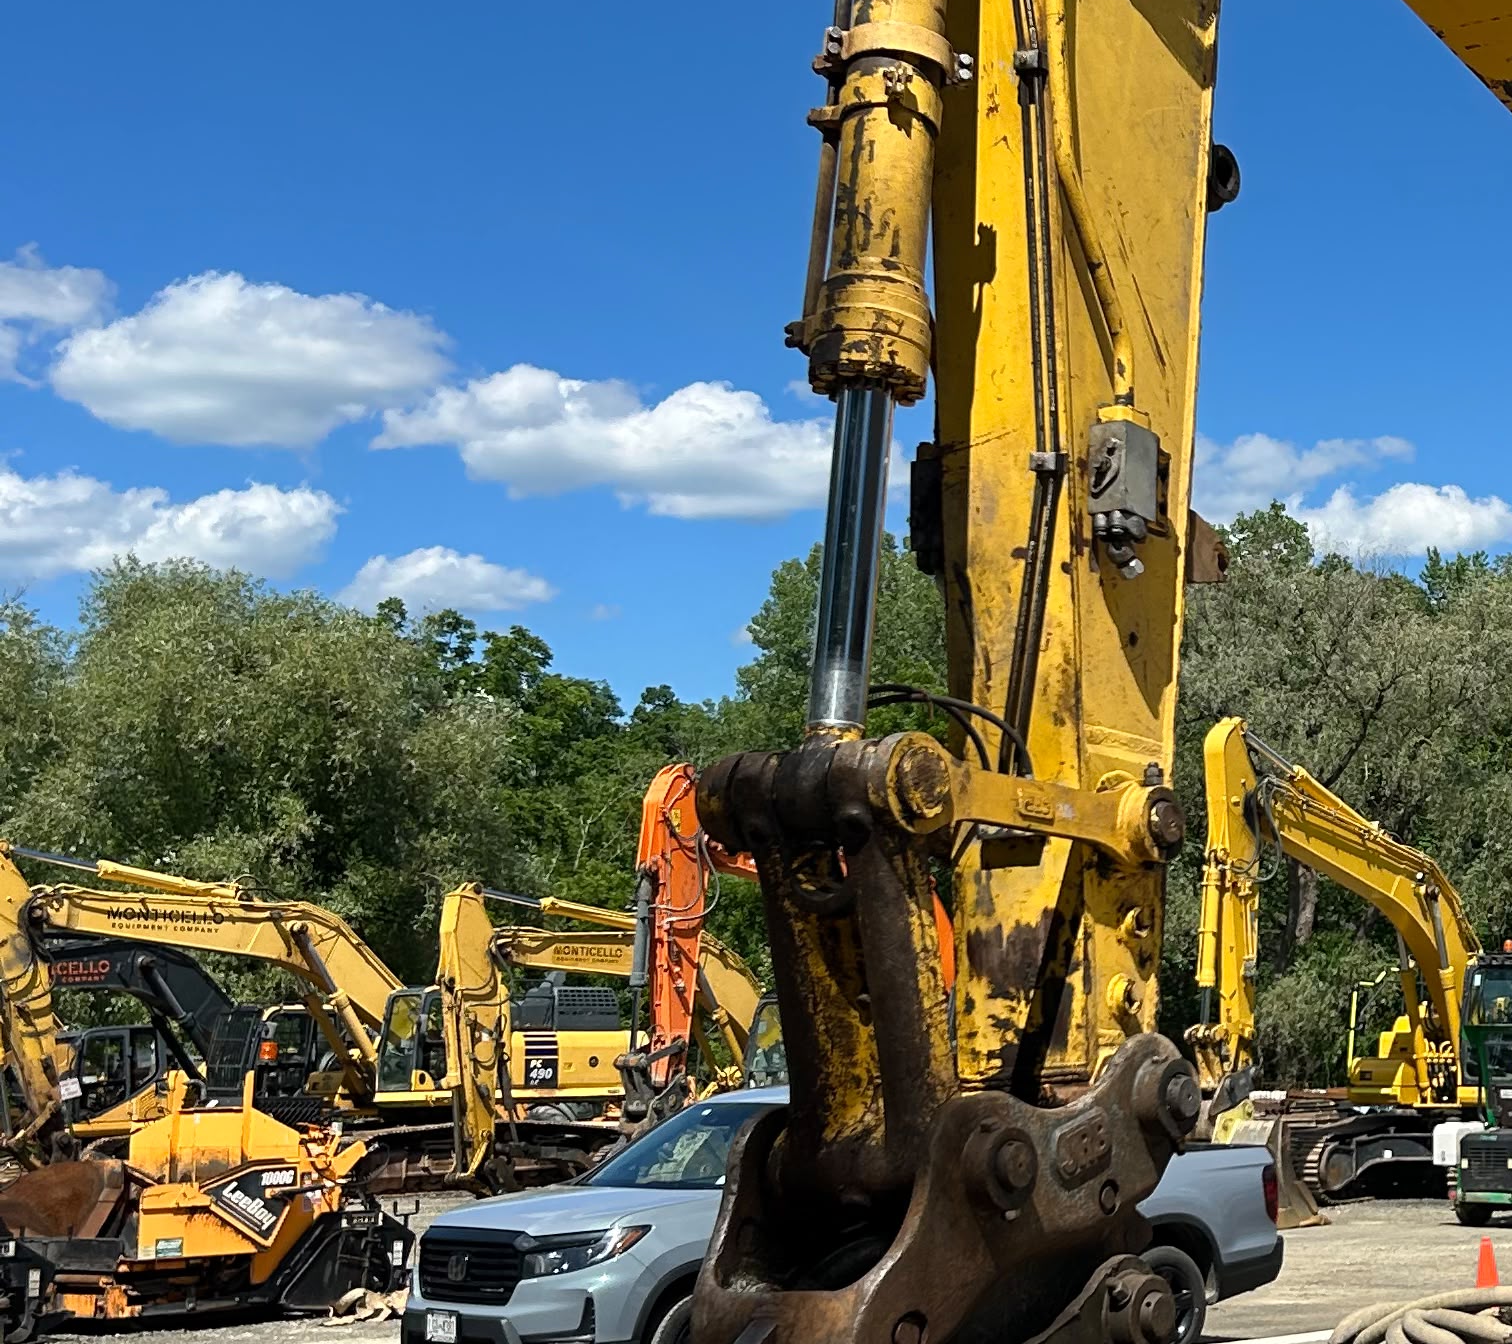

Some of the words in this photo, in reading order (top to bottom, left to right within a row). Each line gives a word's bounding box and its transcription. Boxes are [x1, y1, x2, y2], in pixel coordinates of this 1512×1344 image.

[107, 906, 225, 925] MONTICELLO
[173, 925, 220, 934] COMPANY
[530, 1059, 543, 1069] PC
[530, 1067, 553, 1080] 490
[222, 1181, 277, 1231] LeeBoy
